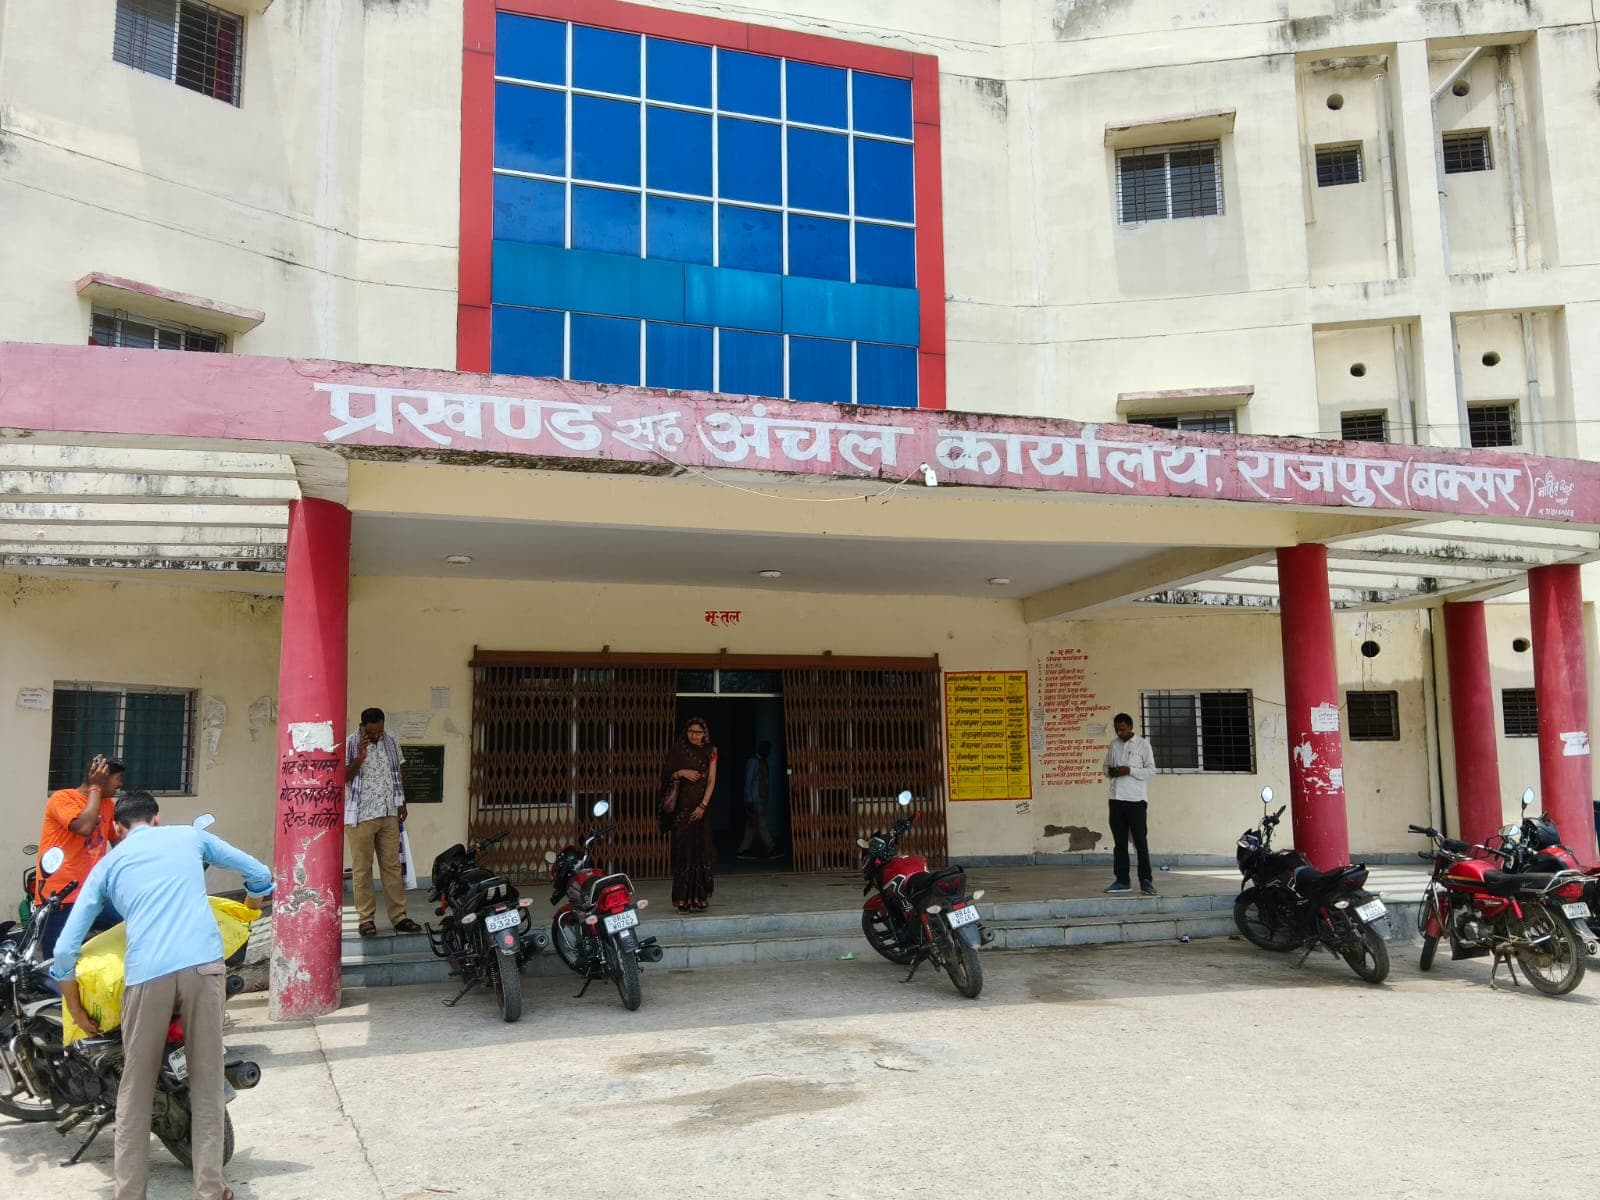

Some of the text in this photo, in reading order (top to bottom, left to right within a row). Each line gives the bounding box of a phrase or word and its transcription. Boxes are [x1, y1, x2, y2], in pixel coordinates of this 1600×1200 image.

[313, 381, 611, 451] प्रखण्ड
[612, 411, 684, 453] सह
[698, 402, 915, 472] अंचल
[934, 424, 1223, 493] कार्यालय,
[1236, 449, 1403, 508] राजपुर
[489, 916, 519, 930] 8326
